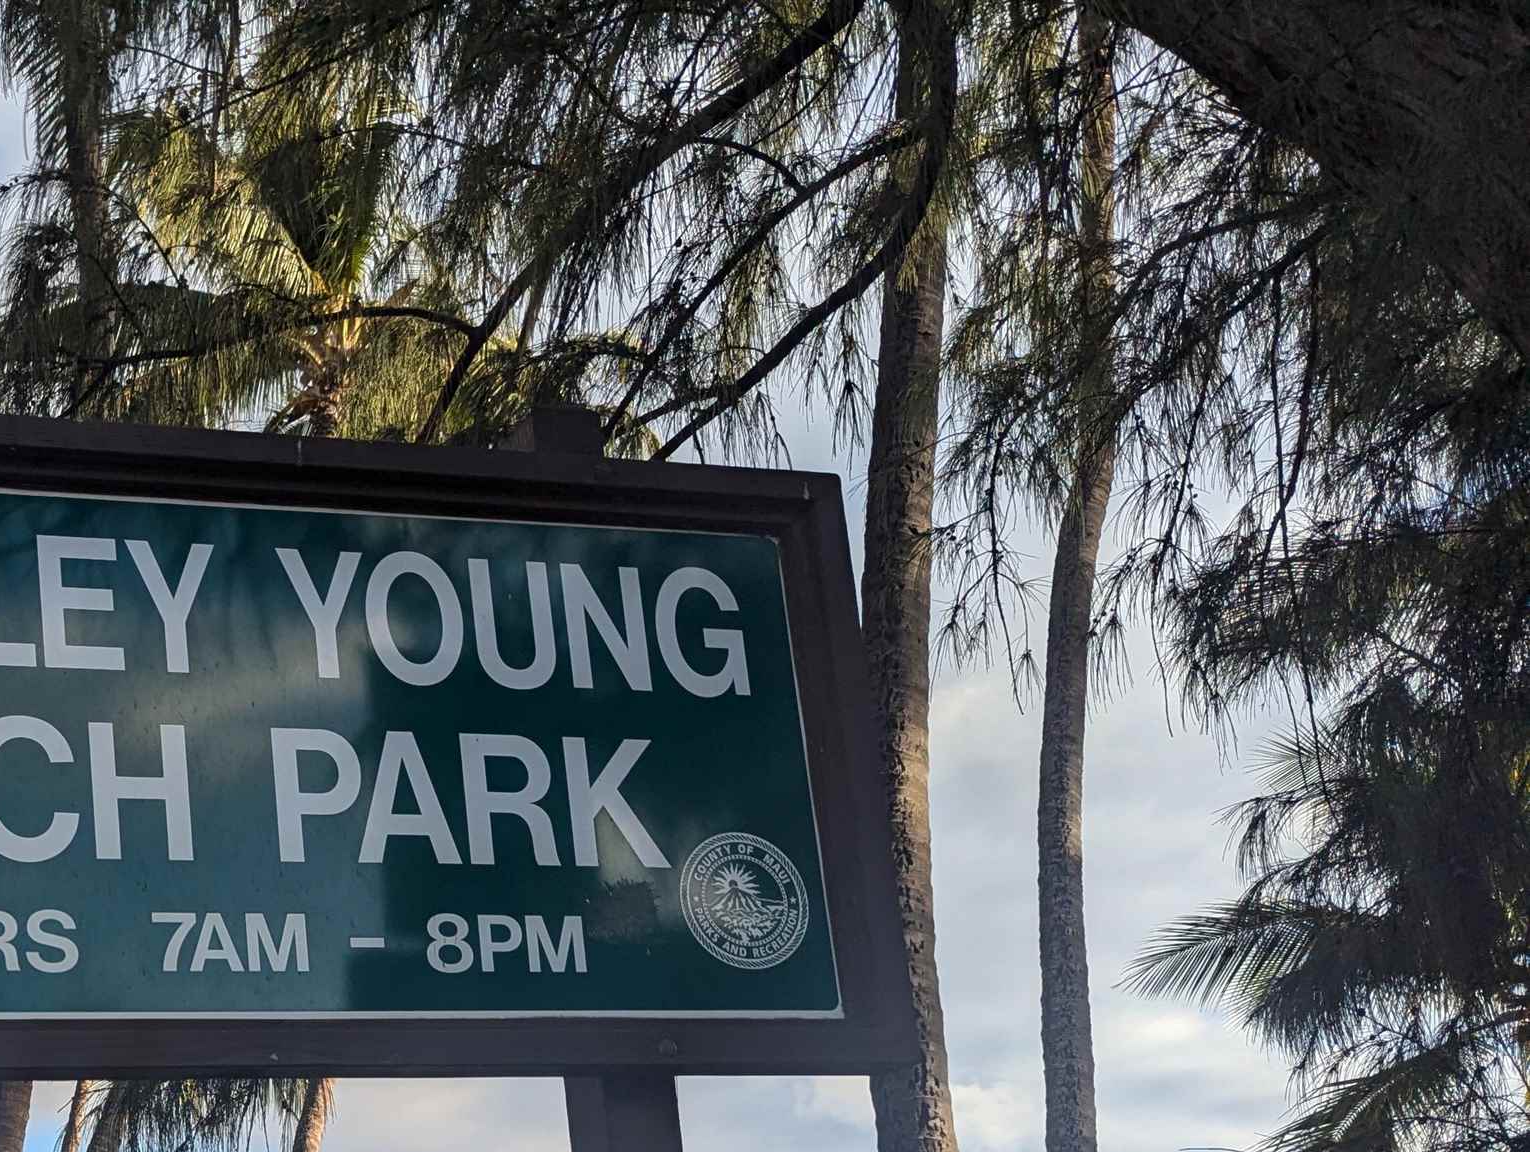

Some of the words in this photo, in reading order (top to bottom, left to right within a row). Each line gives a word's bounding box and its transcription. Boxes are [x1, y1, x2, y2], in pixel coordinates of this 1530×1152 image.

[274, 547, 751, 698] YOUNG
[270, 727, 672, 869] PARK
[694, 844, 731, 881] COUNTY
[737, 843, 754, 855] OF
[762, 853, 792, 885] MAUI
[151, 911, 310, 972] 7AM
[426, 913, 588, 973] 8PM
[694, 907, 721, 943] PARKS
[722, 940, 747, 957] AND
[751, 908, 799, 958] RECREATION
